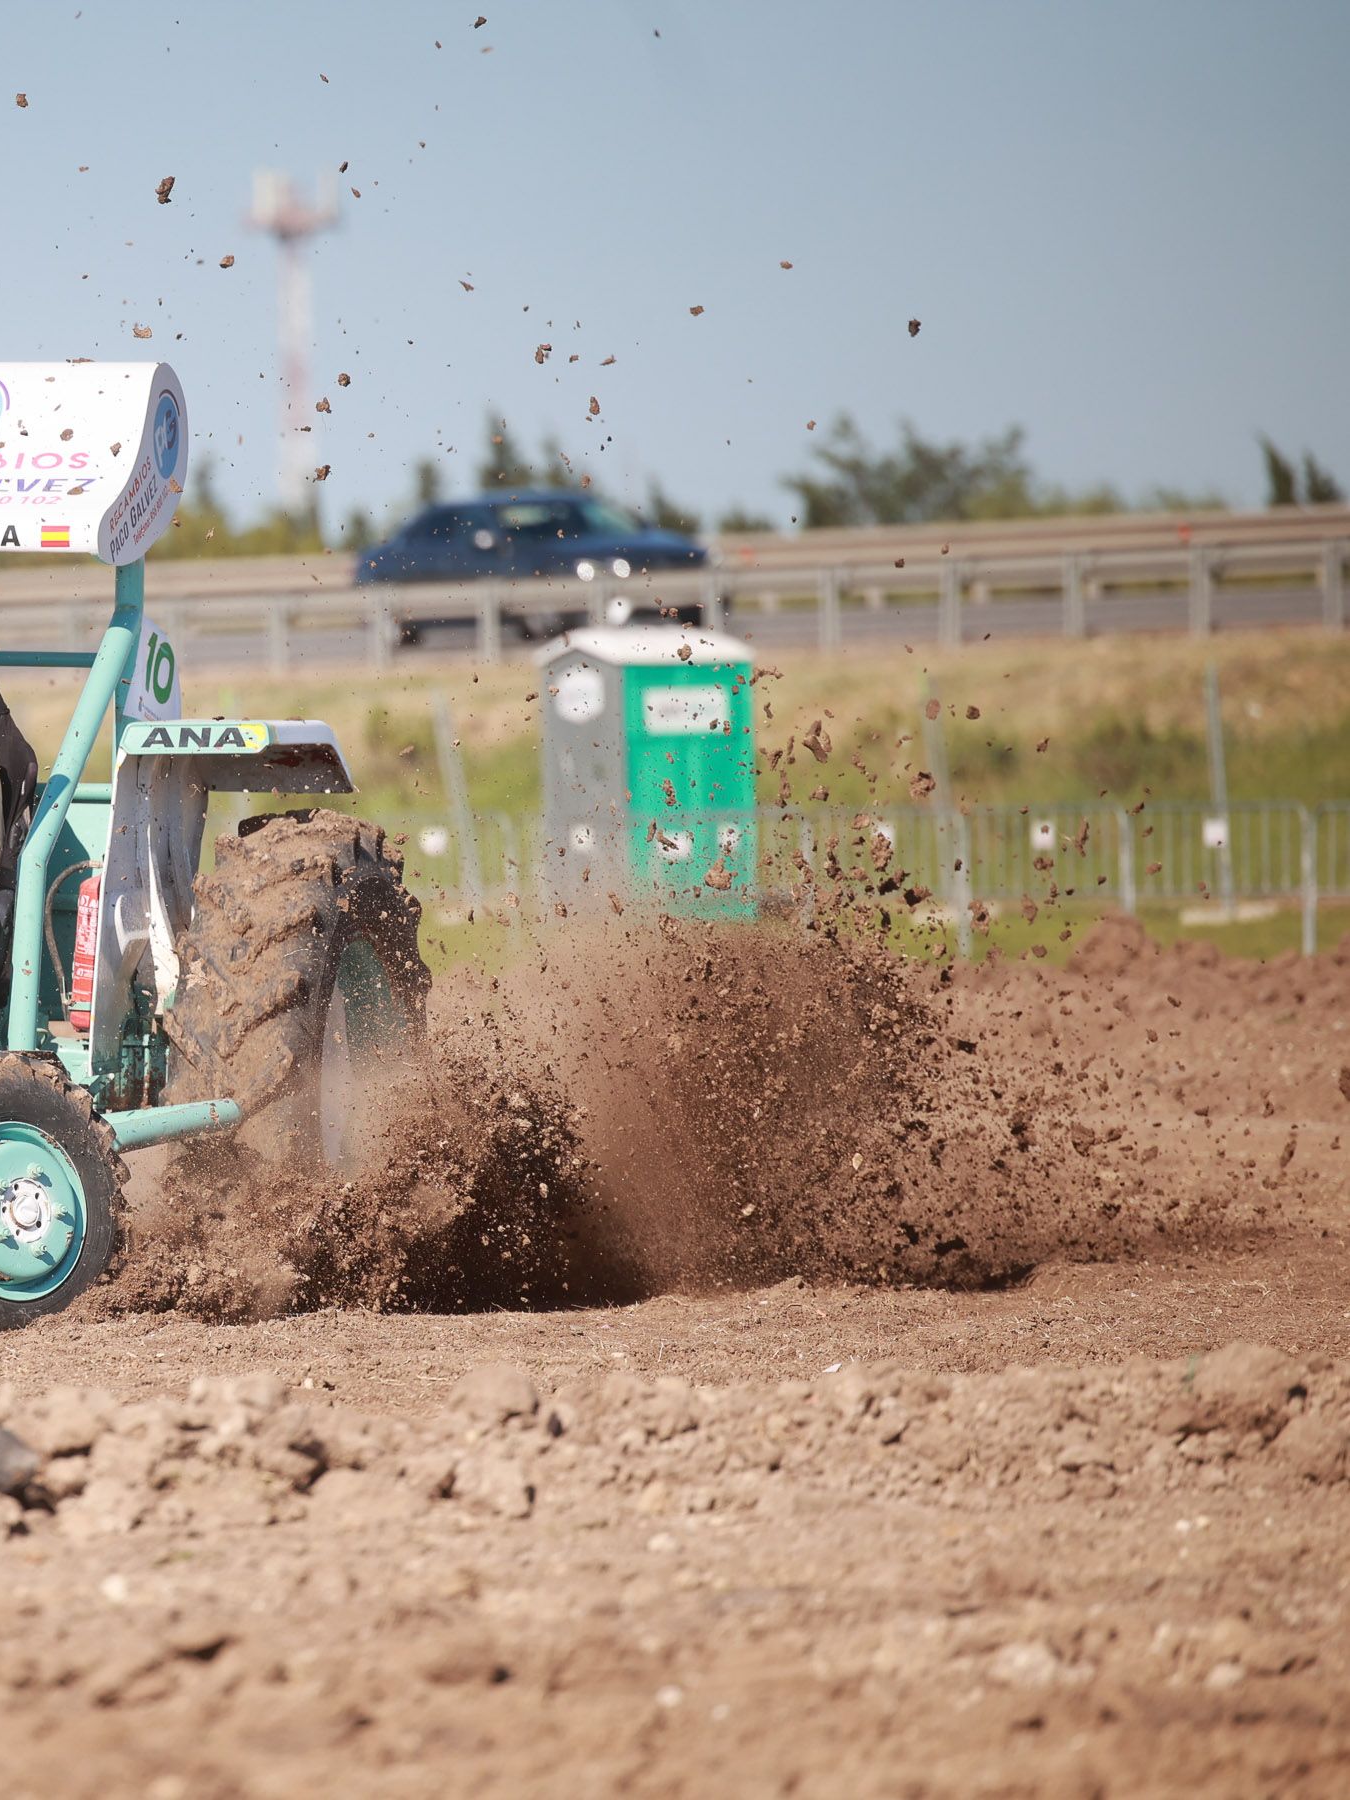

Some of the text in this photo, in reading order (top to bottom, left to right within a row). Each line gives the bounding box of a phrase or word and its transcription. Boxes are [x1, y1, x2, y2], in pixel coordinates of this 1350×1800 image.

[22, 495, 64, 505] 102
[109, 456, 152, 533] RECAMBIOS
[109, 525, 130, 563] PACO
[129, 474, 158, 529] GALVEZ
[145, 632, 175, 704] 10
[141, 727, 246, 748] ANA
